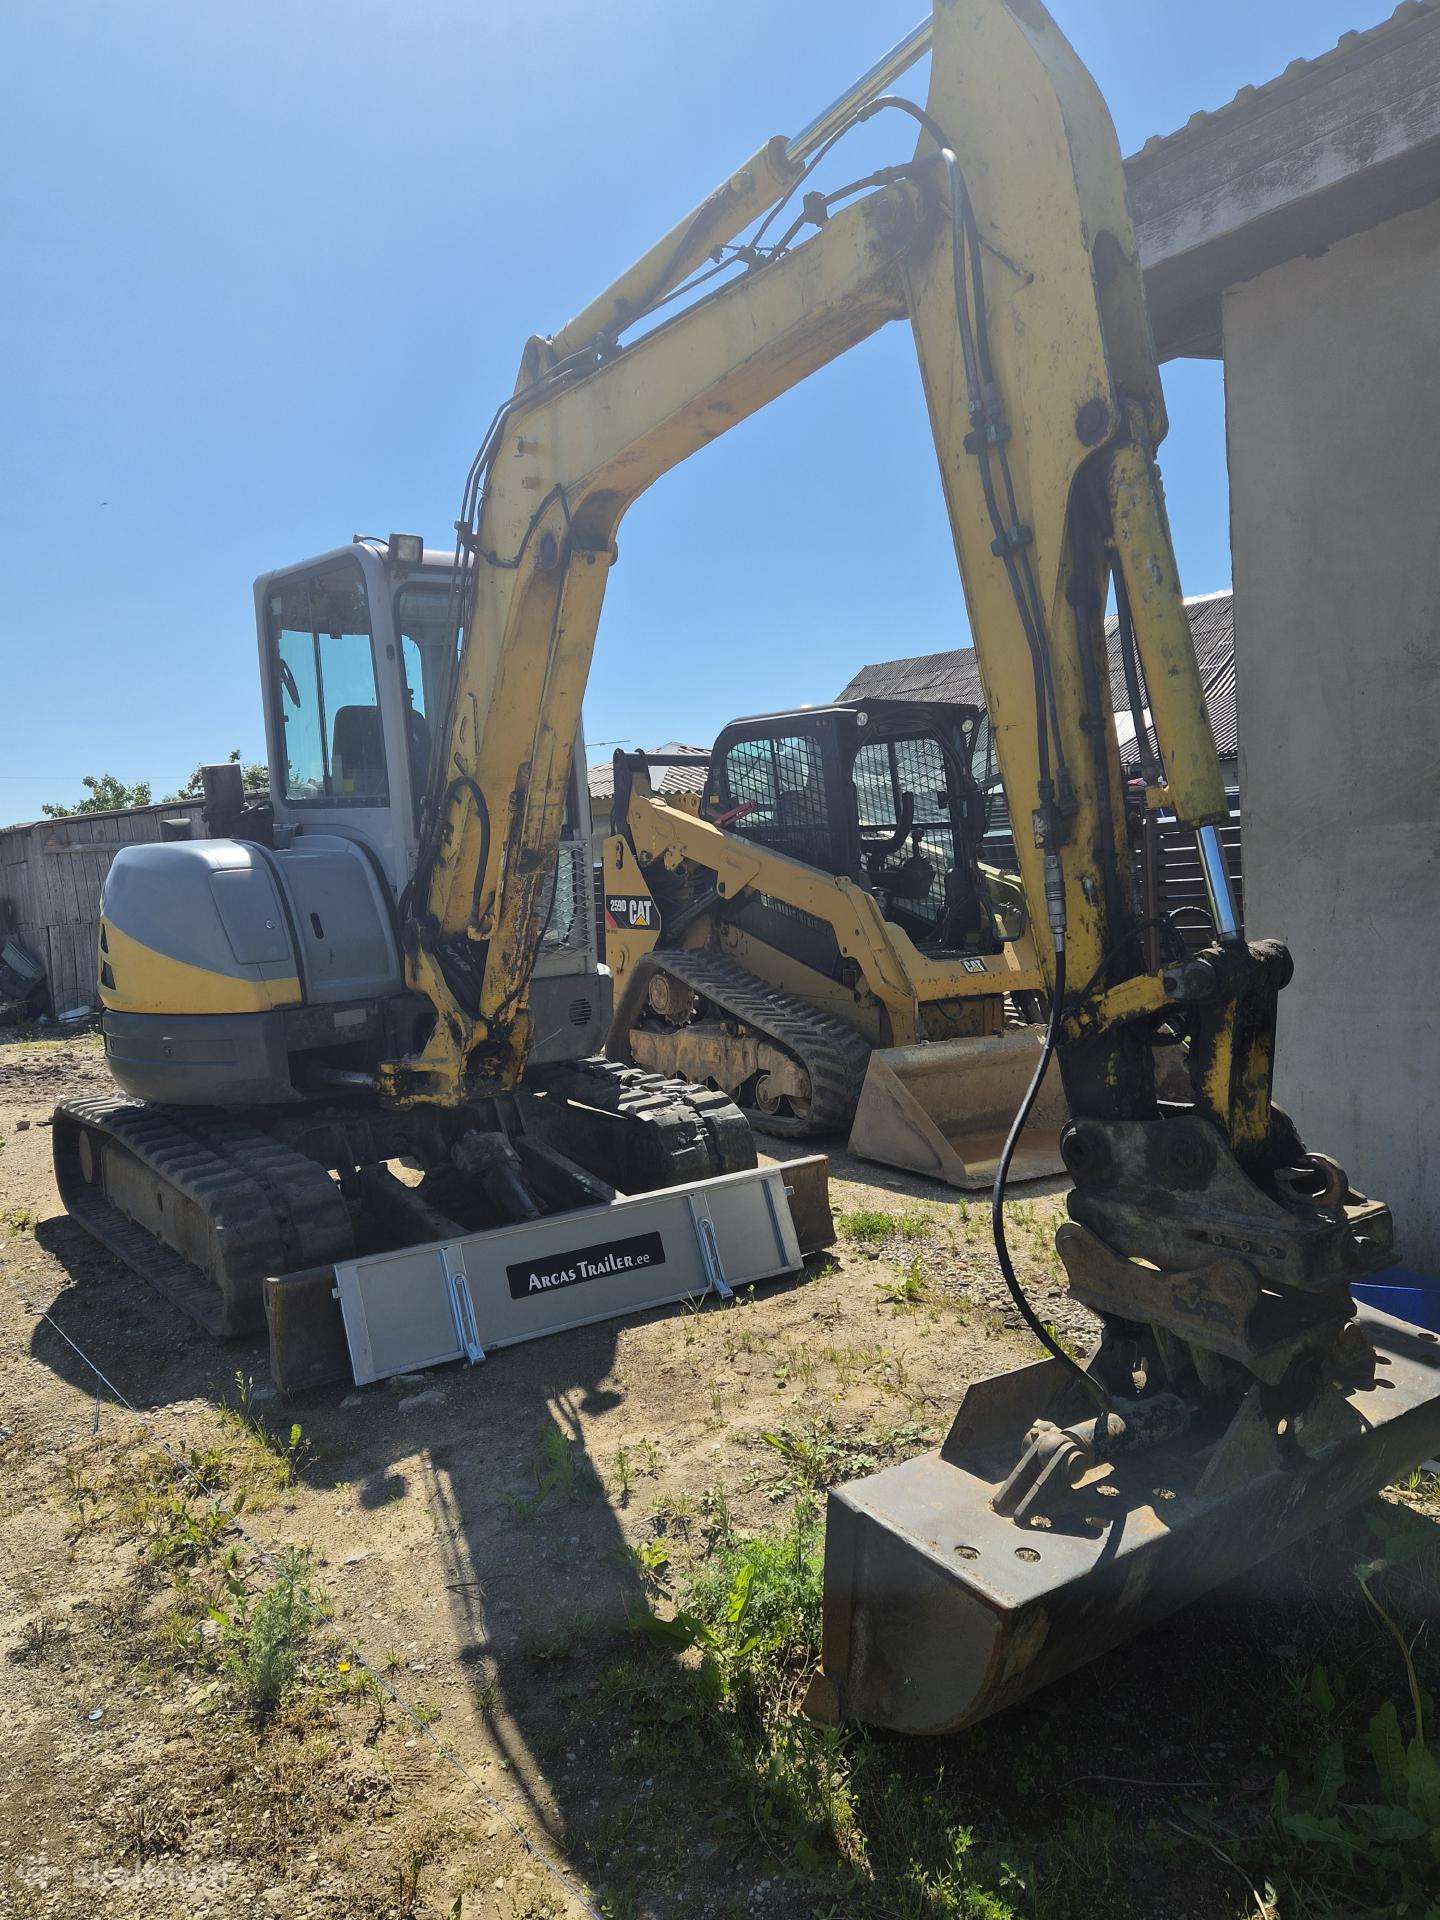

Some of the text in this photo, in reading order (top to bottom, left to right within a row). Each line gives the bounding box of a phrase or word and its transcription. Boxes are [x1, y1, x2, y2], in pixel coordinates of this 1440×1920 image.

[610, 899, 652, 925] 259D CAT
[963, 960, 985, 972] CAT
